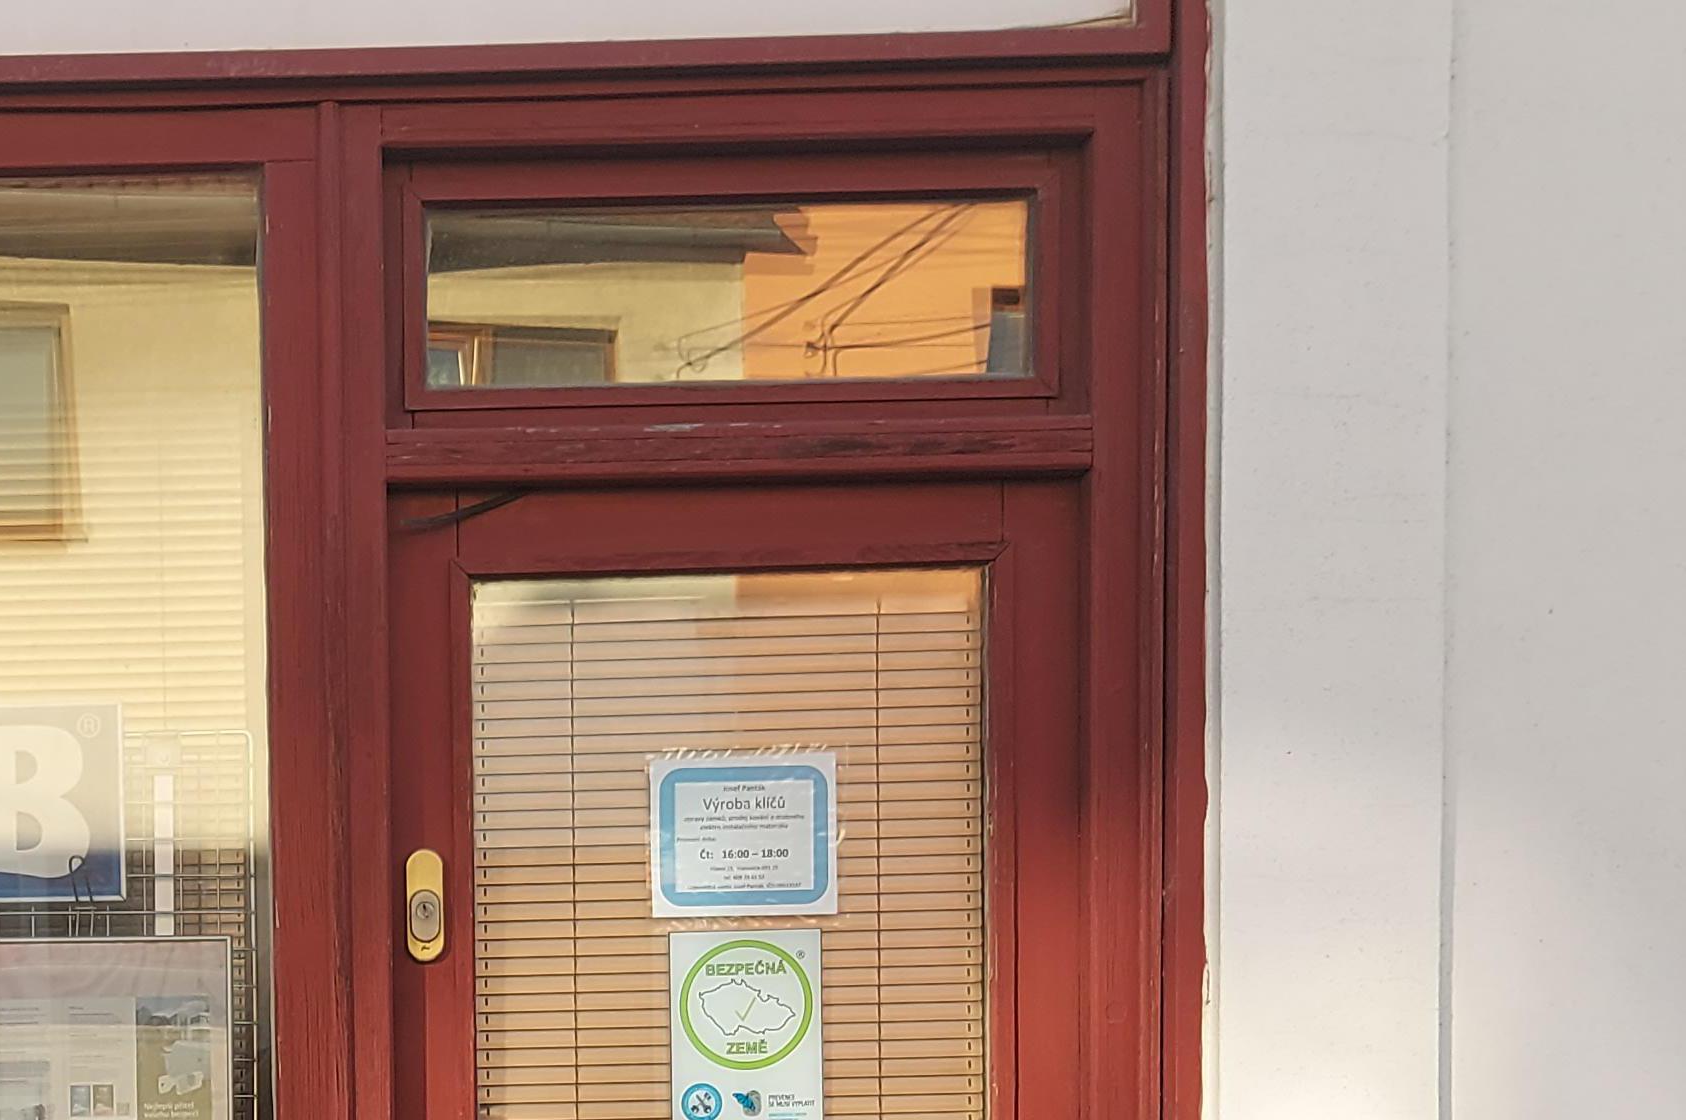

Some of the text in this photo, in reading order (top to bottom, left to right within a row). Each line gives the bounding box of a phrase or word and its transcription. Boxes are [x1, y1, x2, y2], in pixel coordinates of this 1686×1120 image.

[702, 795, 787, 814] Výroba klíčů
[699, 848, 714, 860] Čt:
[722, 849, 750, 860] 16:00
[761, 848, 789, 859] 18:00
[705, 959, 787, 977] BEZPEČNÁ
[726, 1039, 768, 1055] ZEMĚ
